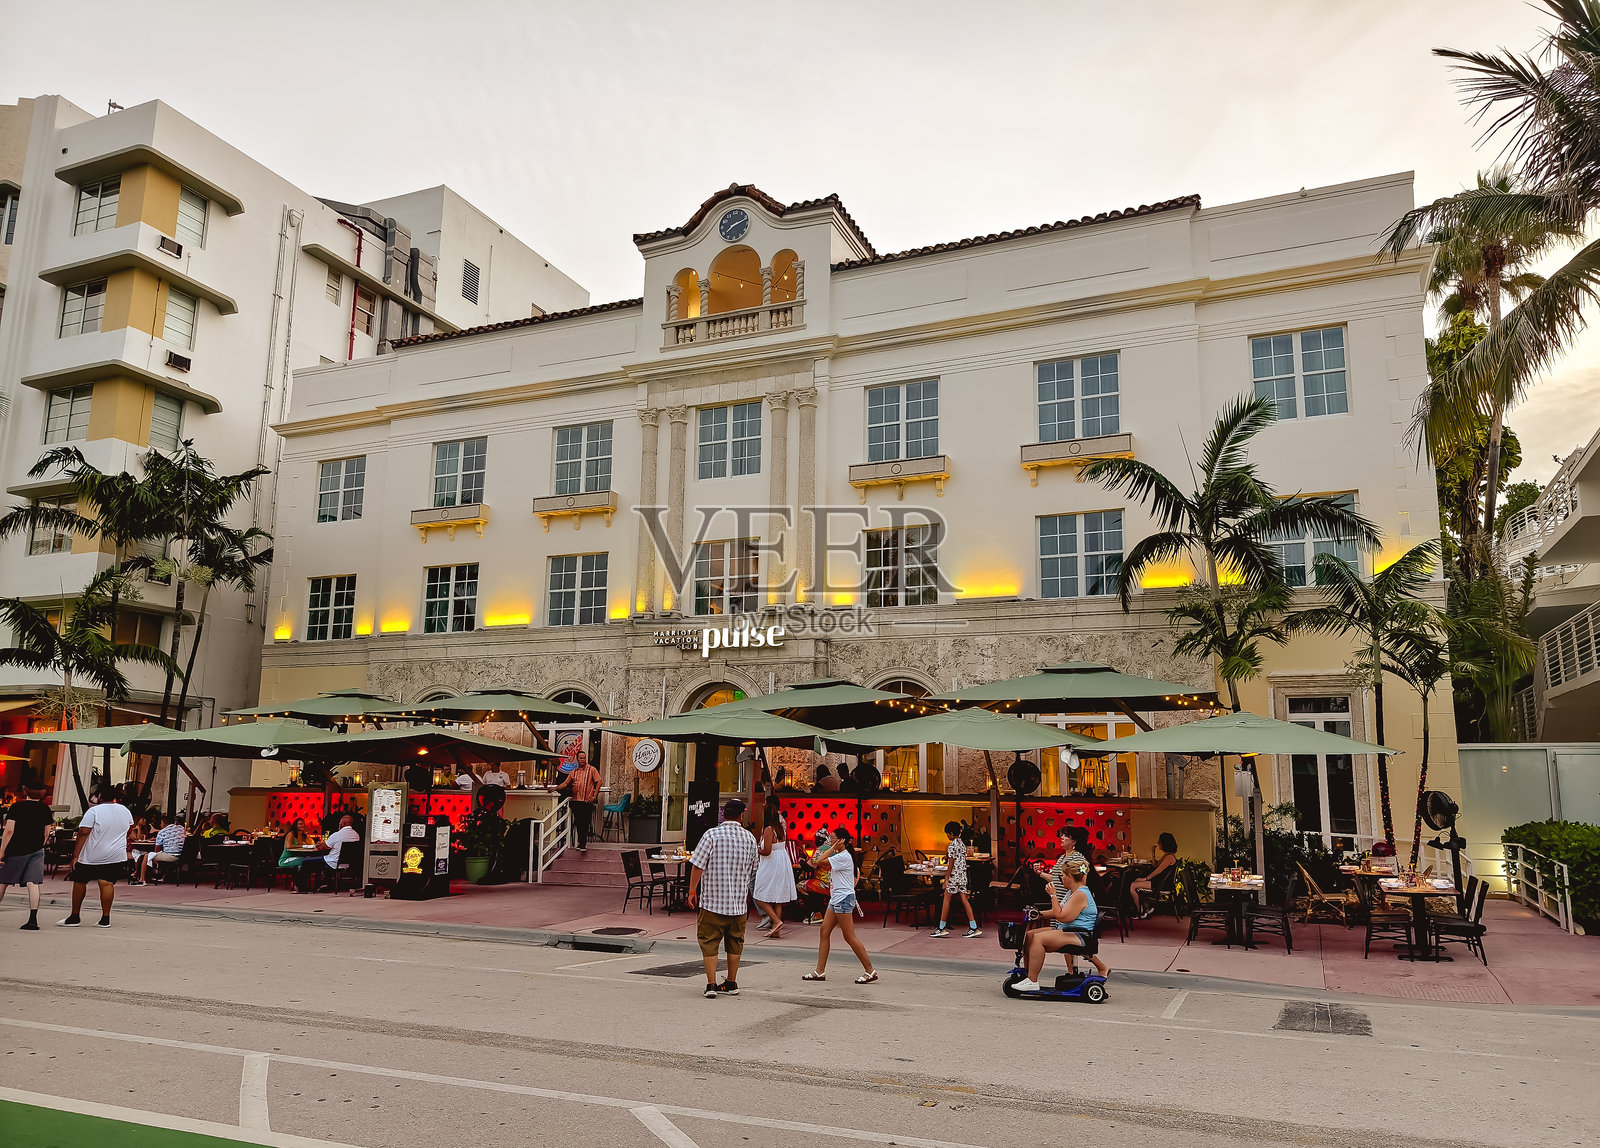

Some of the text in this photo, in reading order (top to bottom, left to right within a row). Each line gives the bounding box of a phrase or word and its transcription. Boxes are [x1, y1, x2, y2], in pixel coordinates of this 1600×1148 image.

[653, 629, 699, 637] MARRIOTT
[653, 636, 699, 645] VACATION
[701, 620, 785, 658] pulse
